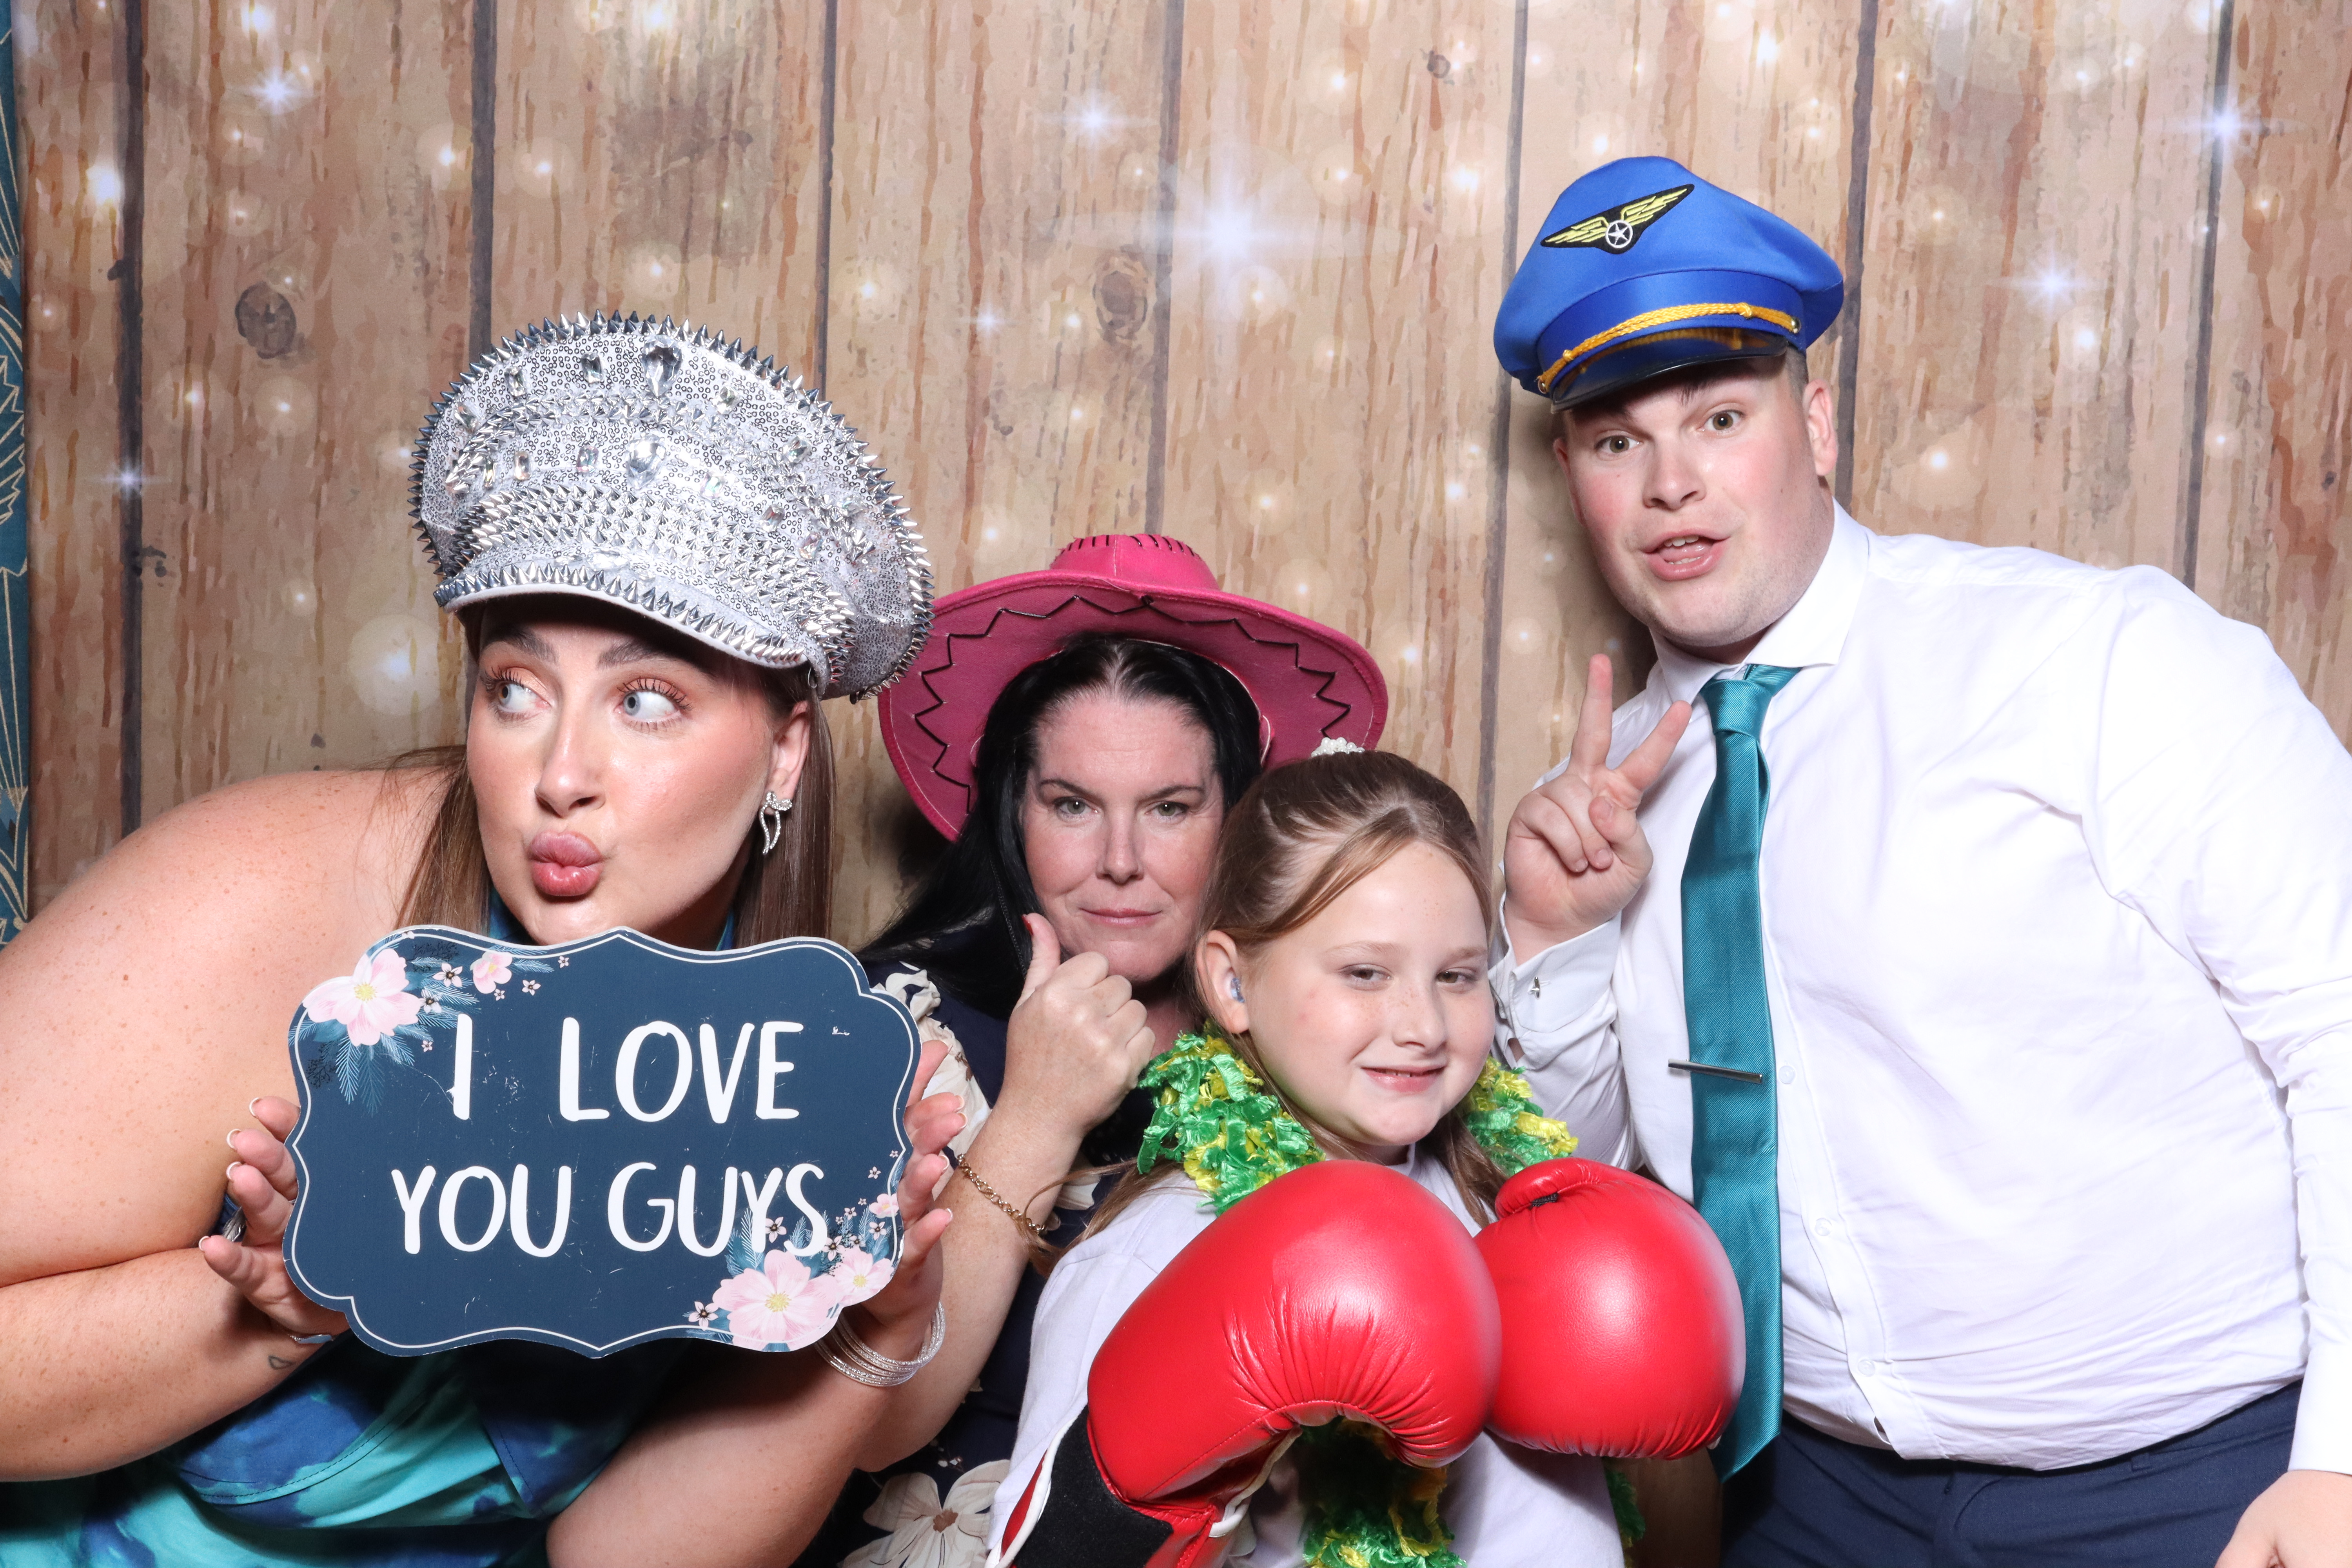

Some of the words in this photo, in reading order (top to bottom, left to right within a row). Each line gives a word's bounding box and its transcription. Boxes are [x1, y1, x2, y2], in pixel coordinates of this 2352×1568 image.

[452, 1014, 473, 1120] I
[559, 1017, 804, 1123] LOVE
[391, 1164, 572, 1257] YOU
[608, 1161, 828, 1257] GUYS
